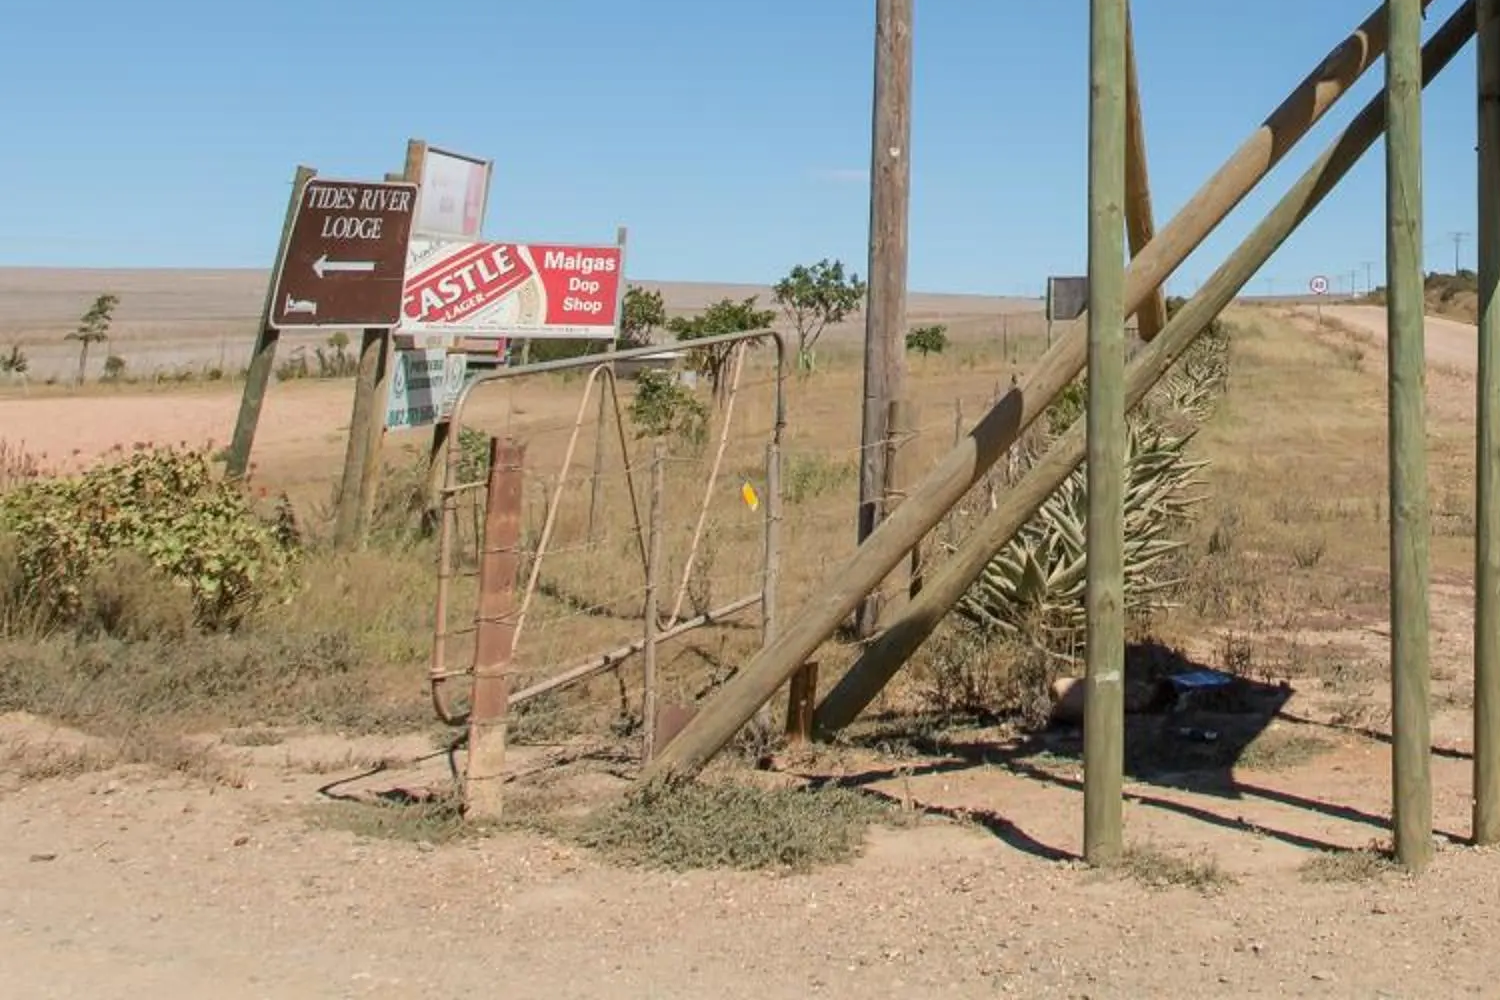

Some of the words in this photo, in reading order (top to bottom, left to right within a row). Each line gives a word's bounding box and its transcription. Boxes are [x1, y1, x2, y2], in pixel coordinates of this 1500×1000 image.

[308, 186, 358, 210] TIDES
[359, 189, 411, 212] RIVER
[321, 215, 383, 239] LODGE
[544, 251, 616, 274] Malgas
[402, 245, 515, 320] CASTLE
[569, 277, 600, 294] Dop
[445, 293, 484, 320] LAGER
[563, 296, 603, 315] Shop
